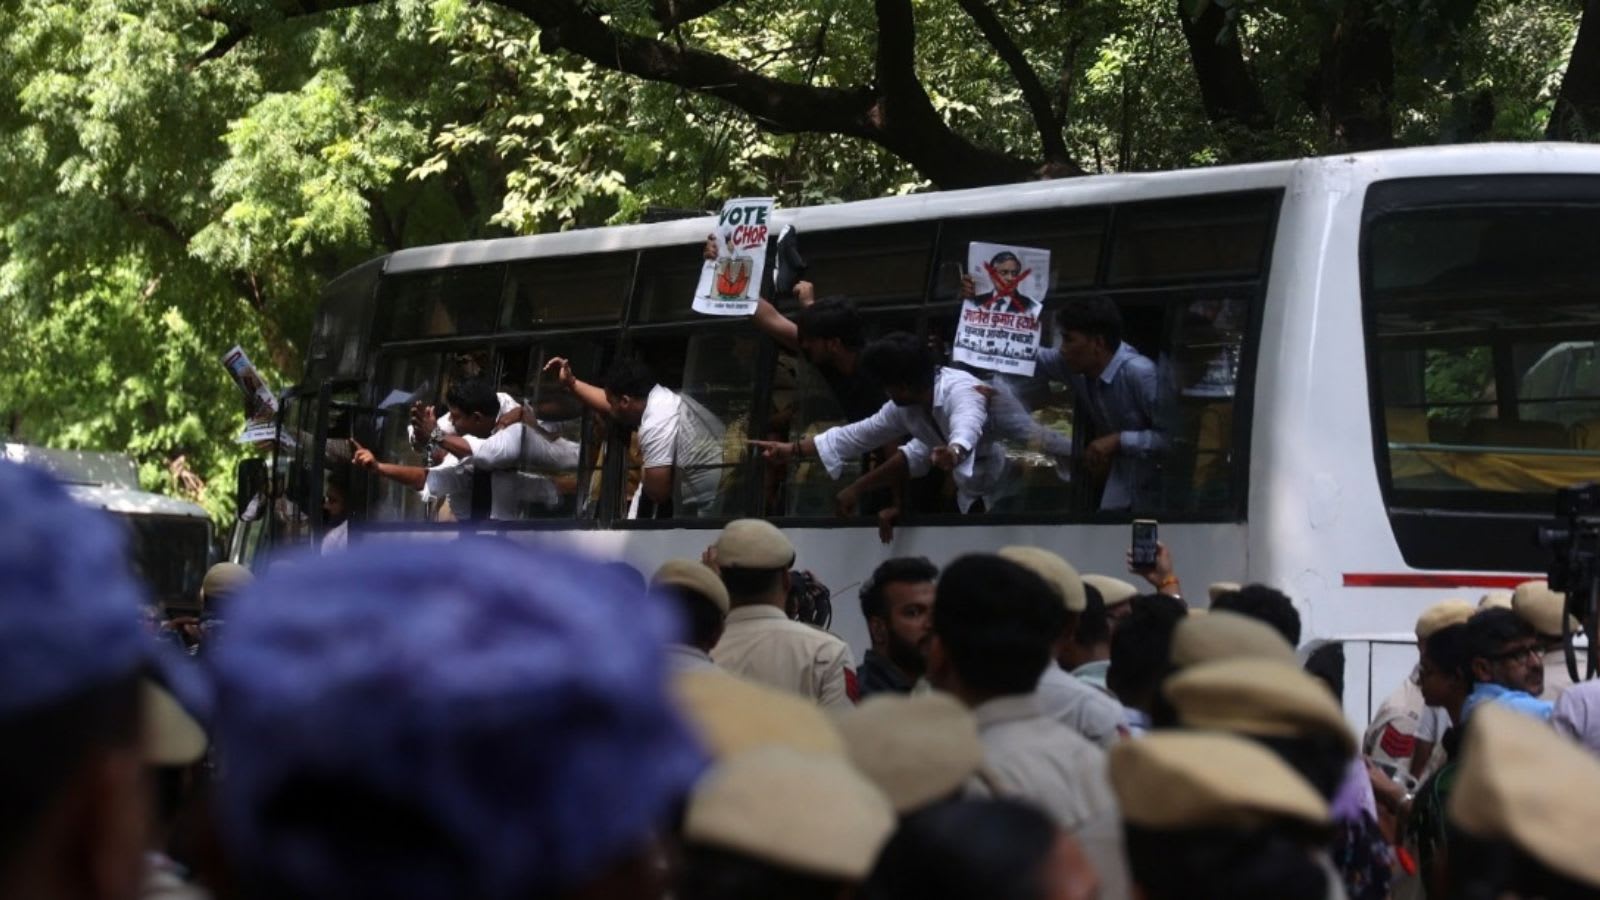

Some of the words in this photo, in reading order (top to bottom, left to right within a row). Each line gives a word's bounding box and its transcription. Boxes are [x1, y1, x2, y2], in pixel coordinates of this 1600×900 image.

[719, 206, 768, 226] VOTE
[733, 225, 767, 245] CHOR
[991, 311, 1015, 328] कुमार
[987, 327, 1009, 338] आयोग
